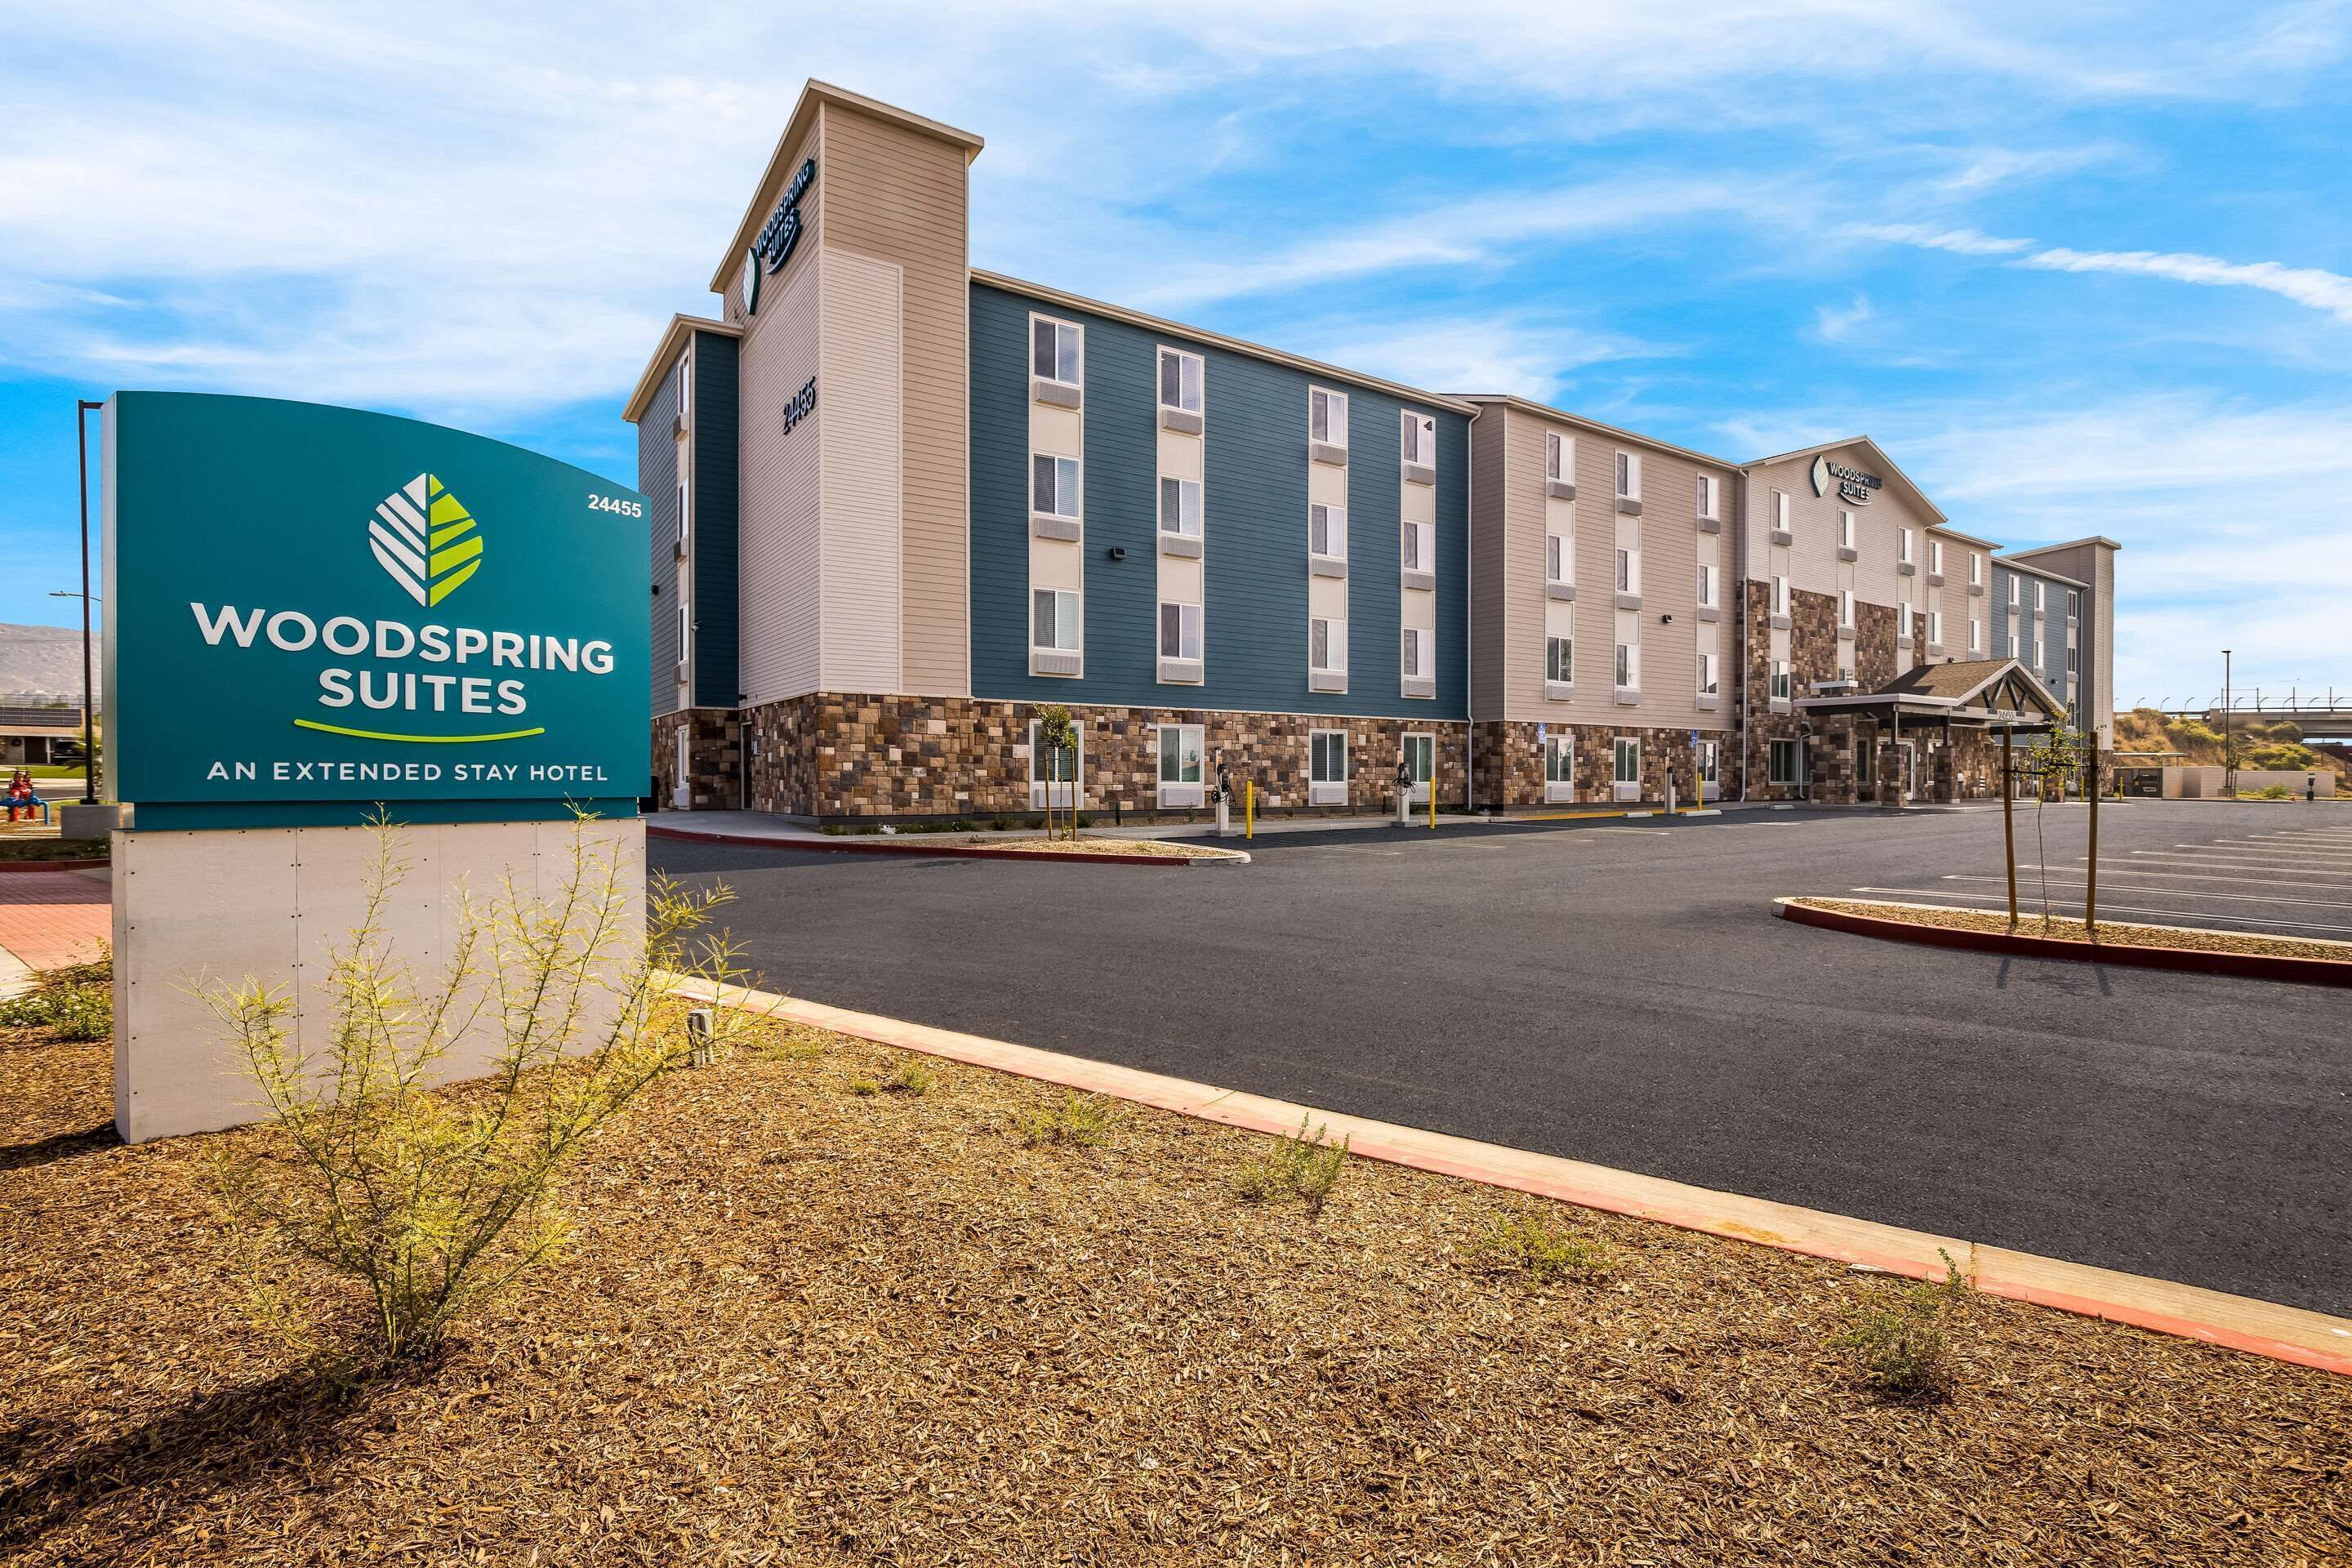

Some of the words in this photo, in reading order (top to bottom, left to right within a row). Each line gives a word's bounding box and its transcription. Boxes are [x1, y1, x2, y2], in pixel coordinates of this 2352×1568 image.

[755, 158, 809, 257] WOODSPRING
[768, 208, 795, 263] SUITES
[783, 376, 815, 434] 24455
[587, 492, 643, 519] 24455
[1843, 481, 1869, 499] SUITES
[190, 602, 614, 675] WOODSPRING
[318, 668, 527, 715] SUITES
[207, 761, 256, 781] AN
[274, 761, 442, 782] EXTENDED
[453, 764, 518, 782] STAY
[530, 765, 608, 782] HOTEL
